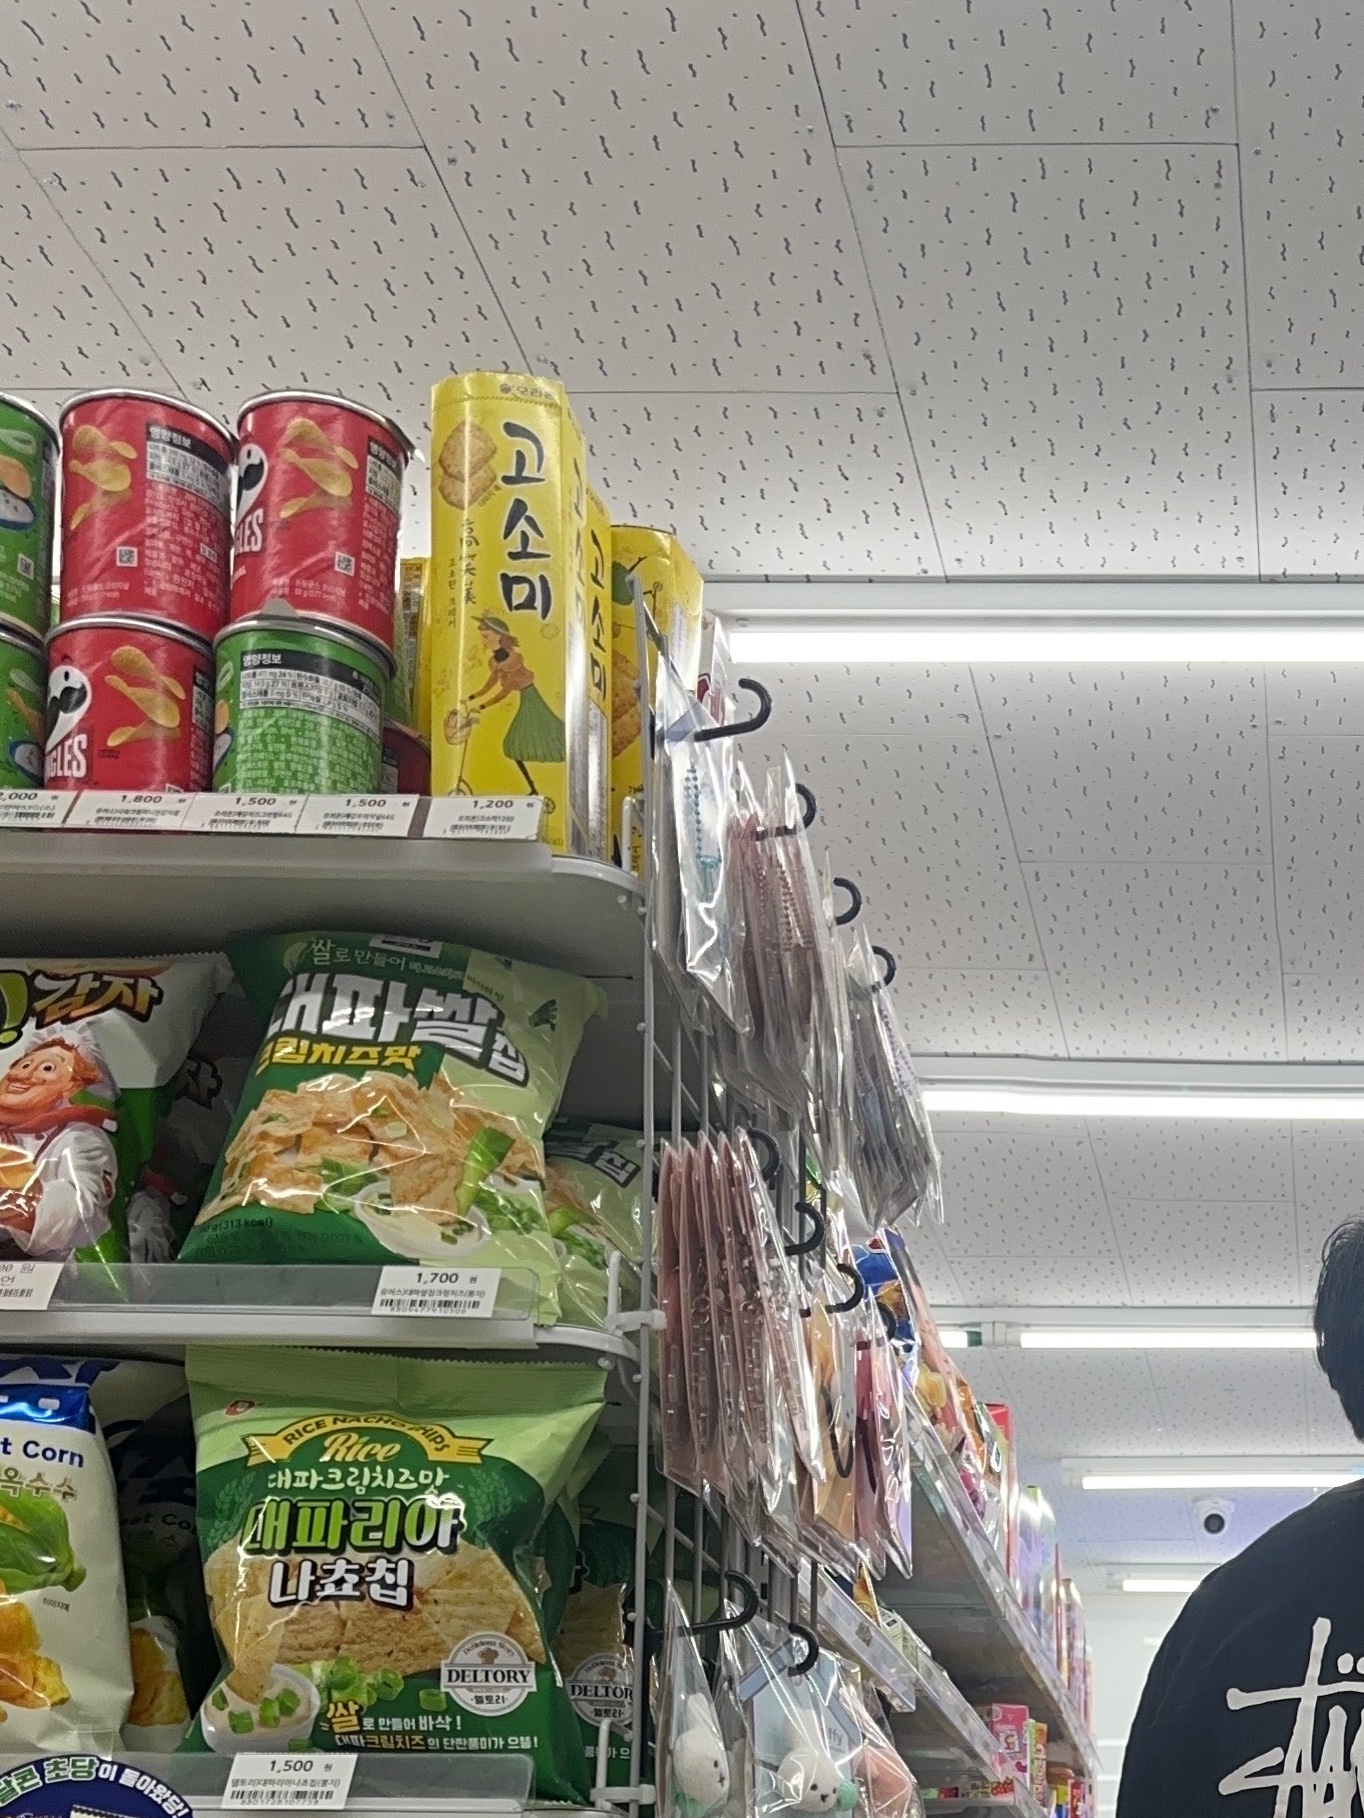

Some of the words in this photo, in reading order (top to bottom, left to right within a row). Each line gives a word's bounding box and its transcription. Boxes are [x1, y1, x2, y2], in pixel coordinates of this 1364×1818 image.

[500, 420, 552, 620] 고소미
[242, 652, 283, 667] 영양정보
[120, 795, 163, 804] 1,800
[234, 796, 277, 807] 1,500
[345, 798, 387, 808] 1,500
[472, 799, 514, 810] 1,200
[310, 938, 351, 966] 쌀로
[416, 1272, 460, 1285] 1,700
[282, 1418, 327, 1446] RICE
[332, 1414, 407, 1431] NACHO
[22, 1439, 85, 1469] Corn
[318, 1431, 402, 1463] Rice
[267, 1466, 450, 1495] 대파크림치즈맛
[241, 1496, 462, 1553] 대파리아
[268, 1557, 415, 1609] 나쵸칩
[446, 1668, 531, 1684] DELTORY
[378, 1717, 417, 1731] 만들어
[43, 1756, 116, 1782] 초당이
[269, 1759, 314, 1773] 1,500
